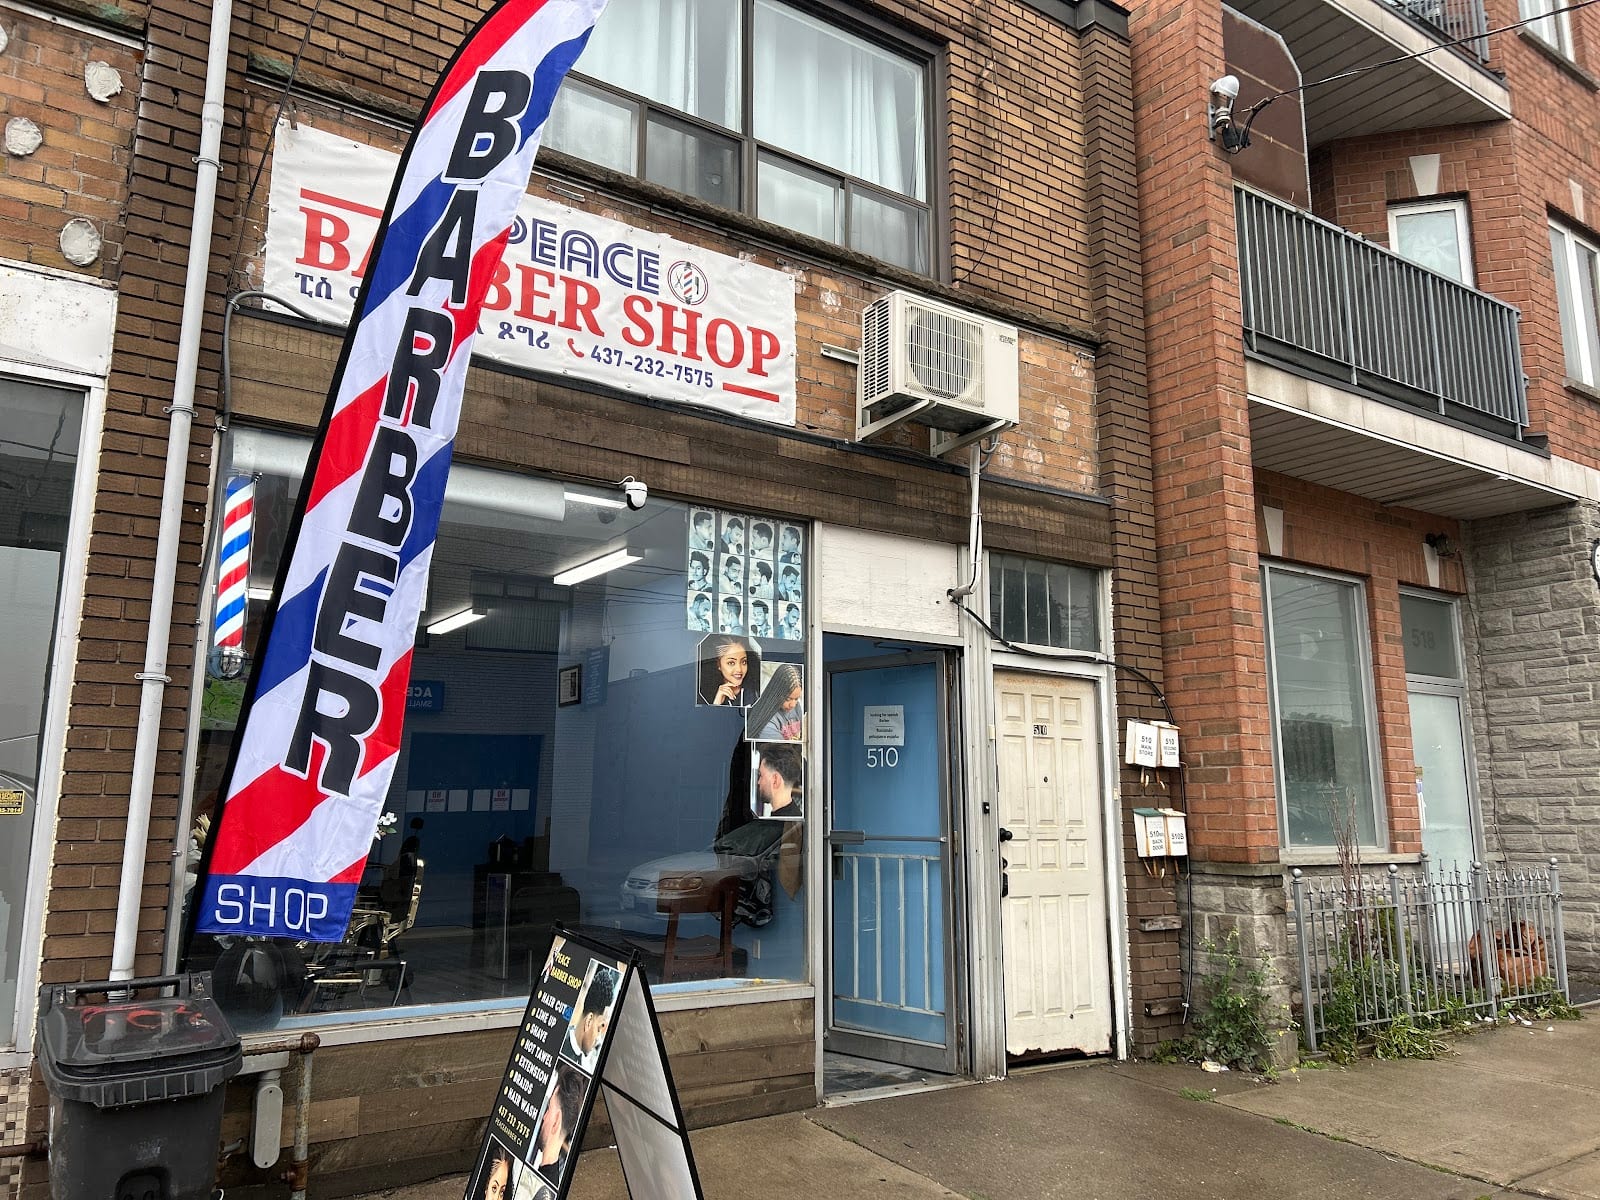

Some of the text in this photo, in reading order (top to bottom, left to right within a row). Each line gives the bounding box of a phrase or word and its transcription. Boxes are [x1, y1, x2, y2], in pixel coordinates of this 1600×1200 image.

[621, 294, 781, 378] SHOP
[590, 345, 714, 389] 437-232-7575
[285, 70, 532, 797] BARBER
[1033, 724, 1048, 736] 510
[1141, 735, 1152, 744] 510
[866, 747, 899, 768] 510
[215, 883, 329, 932] SHOP
[555, 952, 571, 968] PEACE
[550, 966, 582, 990] BARBER SHOP
[541, 991, 567, 1015] HAIR CUT
[535, 1007, 557, 1029] LINE UP
[530, 1023, 549, 1043] SHAVE
[524, 1038, 537, 1055] HOT
[518, 1054, 549, 1085] EXTENSION
[513, 1071, 533, 1095] BRAIDS
[507, 1087, 539, 1120] HAIR WASH
